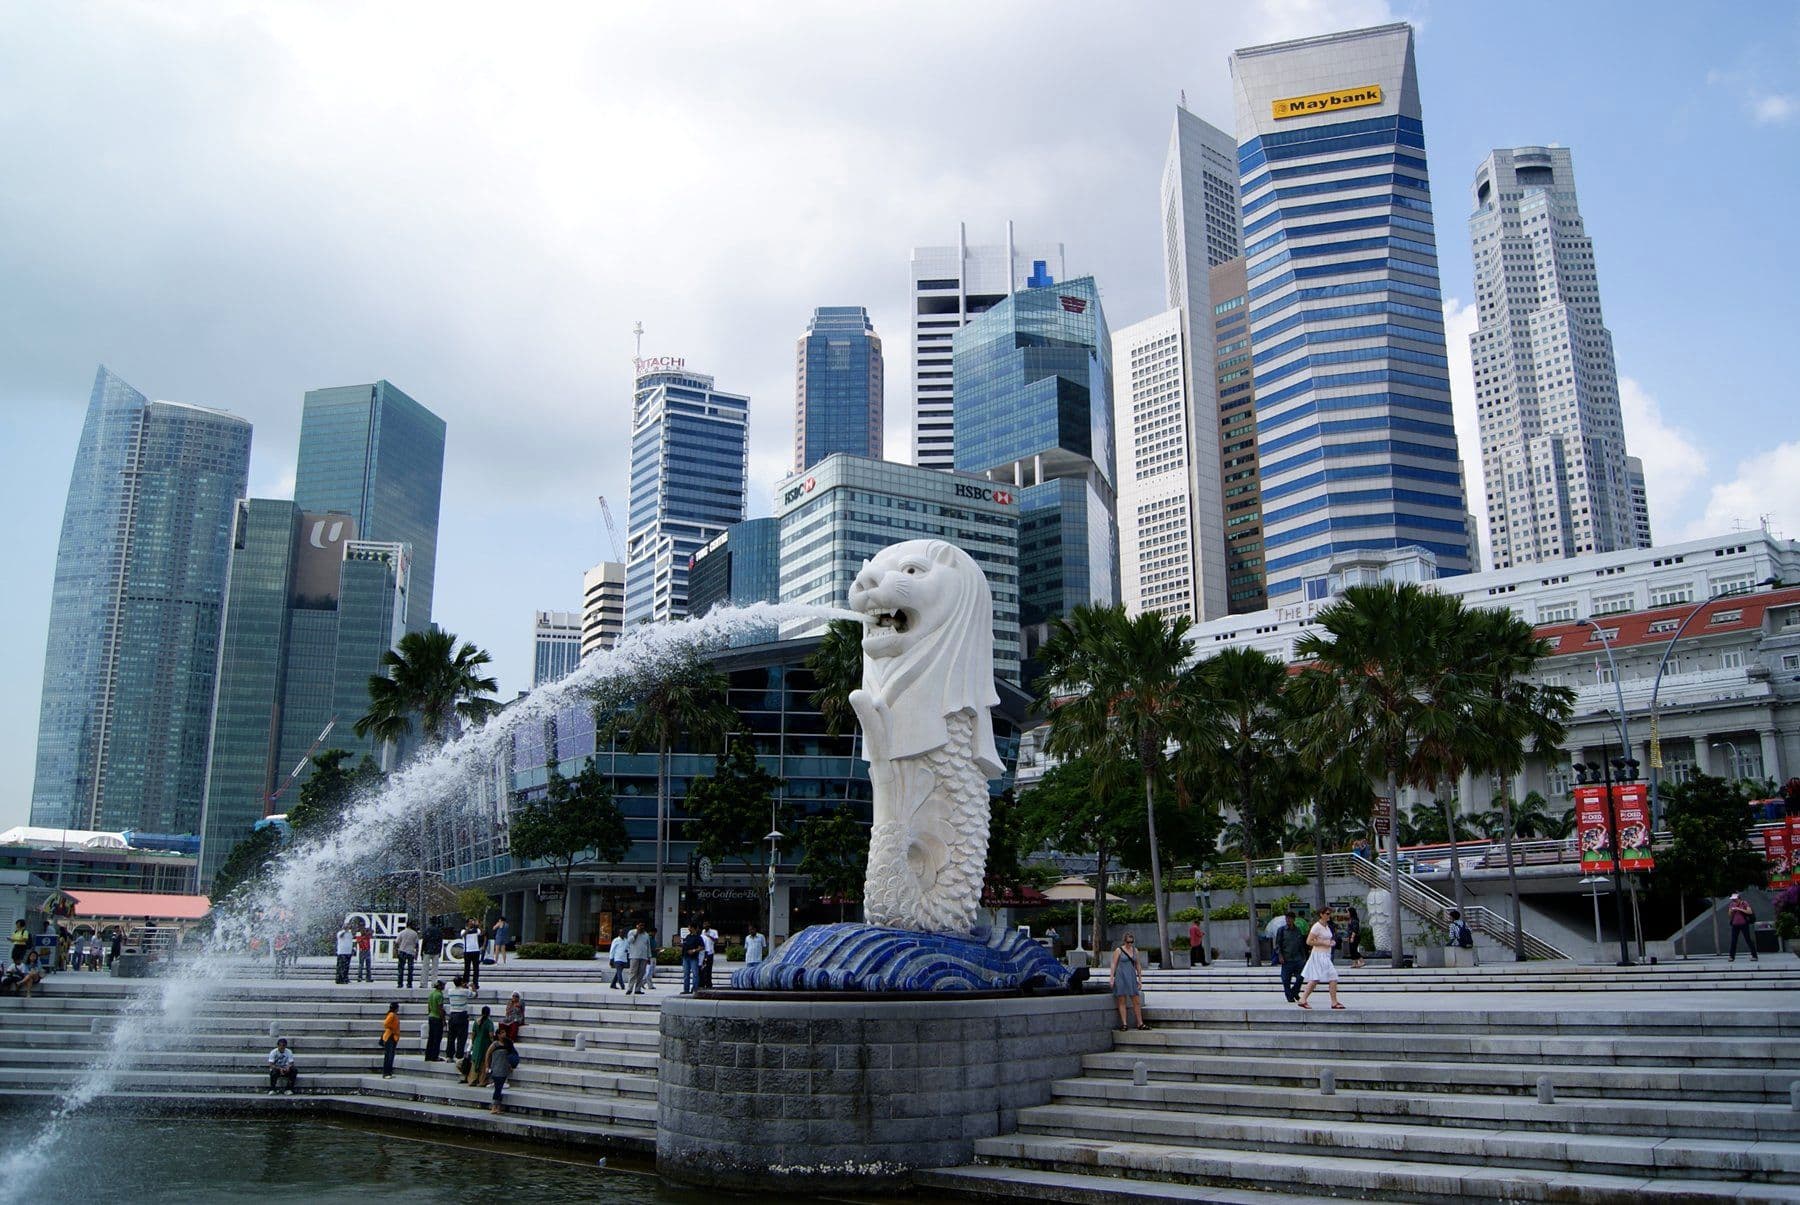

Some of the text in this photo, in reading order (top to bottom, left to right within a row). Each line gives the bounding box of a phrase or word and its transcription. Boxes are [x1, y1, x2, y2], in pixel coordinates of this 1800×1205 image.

[1289, 91, 1378, 111] Maybank
[784, 483, 804, 505] HSBC
[955, 483, 992, 501] HSBC
[1274, 606, 1301, 621] THE
[342, 912, 408, 936] ONE
